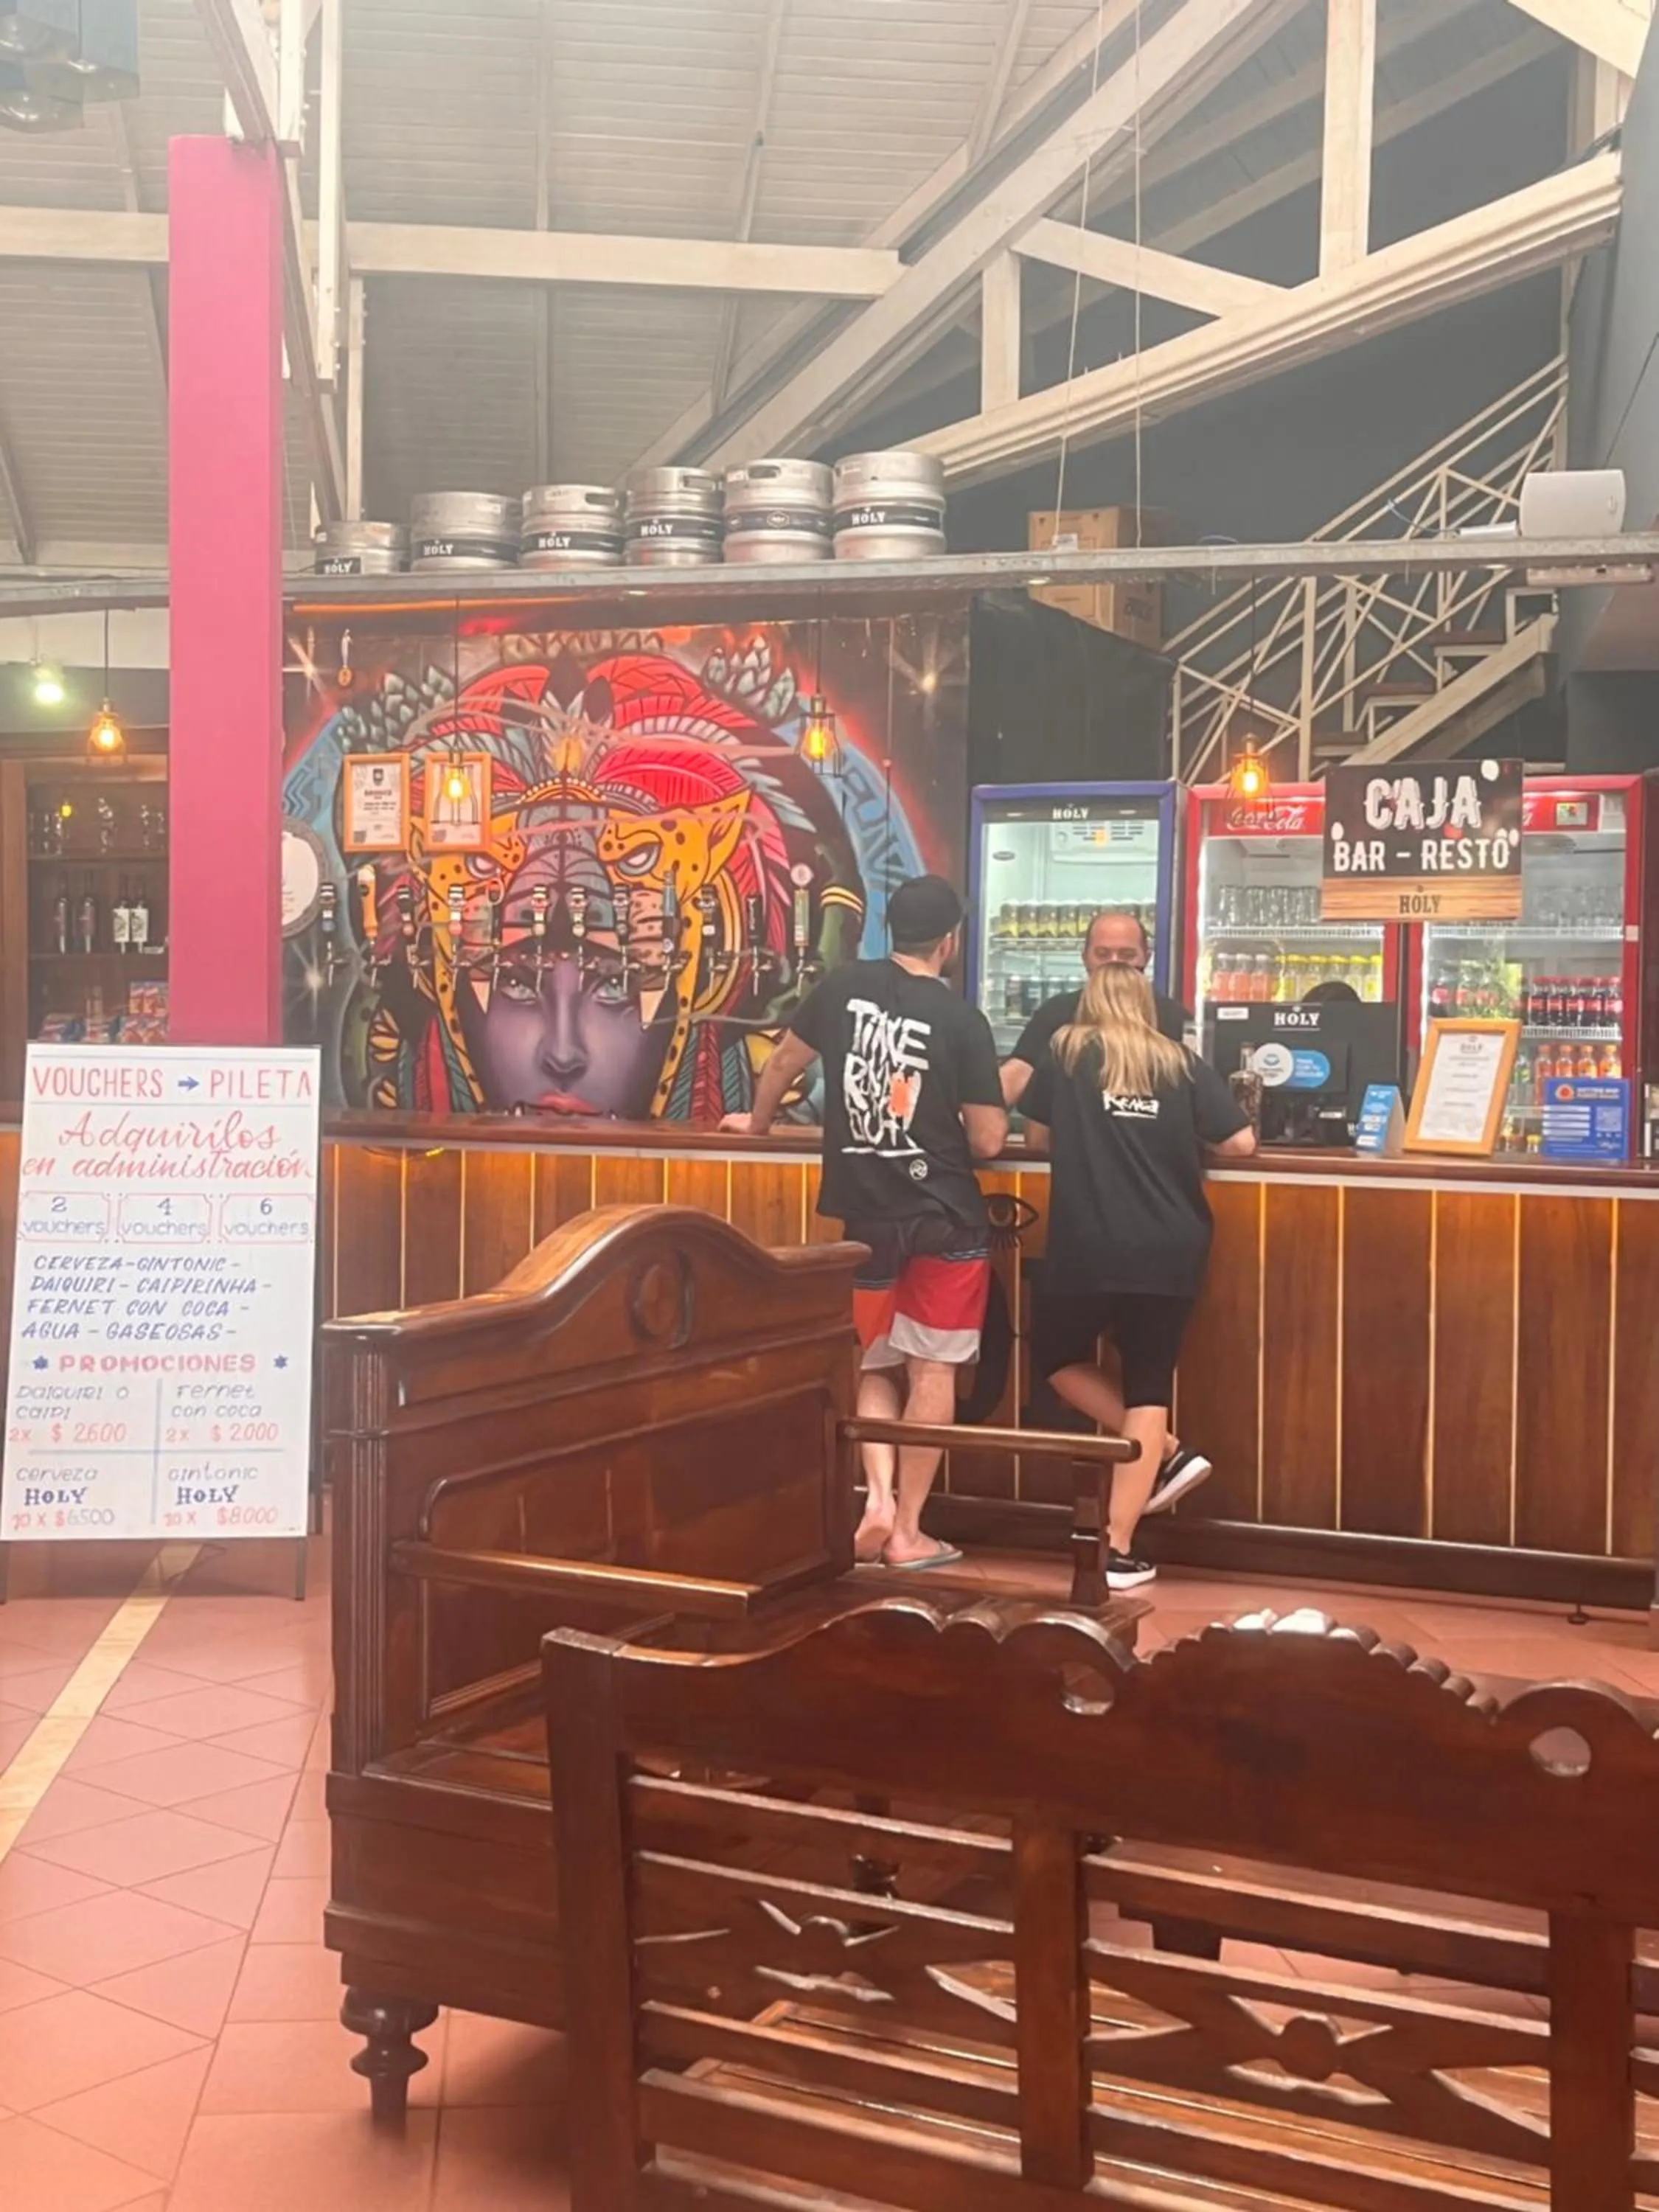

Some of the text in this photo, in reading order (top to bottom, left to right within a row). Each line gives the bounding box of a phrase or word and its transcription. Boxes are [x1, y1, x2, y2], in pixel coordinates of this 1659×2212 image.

[852, 512, 886, 524] HOLY
[641, 524, 673, 536] HOLY
[424, 543, 453, 556] HOLY
[539, 537, 571, 549] HOLY
[1363, 776, 1482, 830] CAJA
[1052, 808, 1089, 820] HOLY
[1333, 841, 1386, 872] BAR
[1398, 895, 1442, 914] HOLY
[1274, 1012, 1321, 1026] HOLY
[32, 1066, 312, 1099] VOUCHERS PILETA
[23, 1149, 313, 1179] en administración
[51, 1195, 67, 1212] 2
[157, 1197, 173, 1215] 4
[260, 1197, 273, 1215] 6
[23, 1219, 105, 1234] vouchers
[122, 1220, 206, 1236] vouchers
[224, 1221, 309, 1236] vouchers
[30, 1276, 116, 1293] DAIQUIRI
[136, 1278, 257, 1294] CAIPIRINHA
[27, 1298, 116, 1315] FERNET
[126, 1299, 168, 1316] CON
[181, 1300, 229, 1317] COCA
[21, 1321, 80, 1340] AGUA
[106, 1322, 223, 1340] GASEOSAS
[59, 1354, 257, 1373] PROMOCIONES
[171, 1405, 262, 1419] con coca
[15, 1467, 100, 1482] cerveza
[24, 1486, 88, 1506] HOLY
[175, 1484, 240, 1506] HOLY
